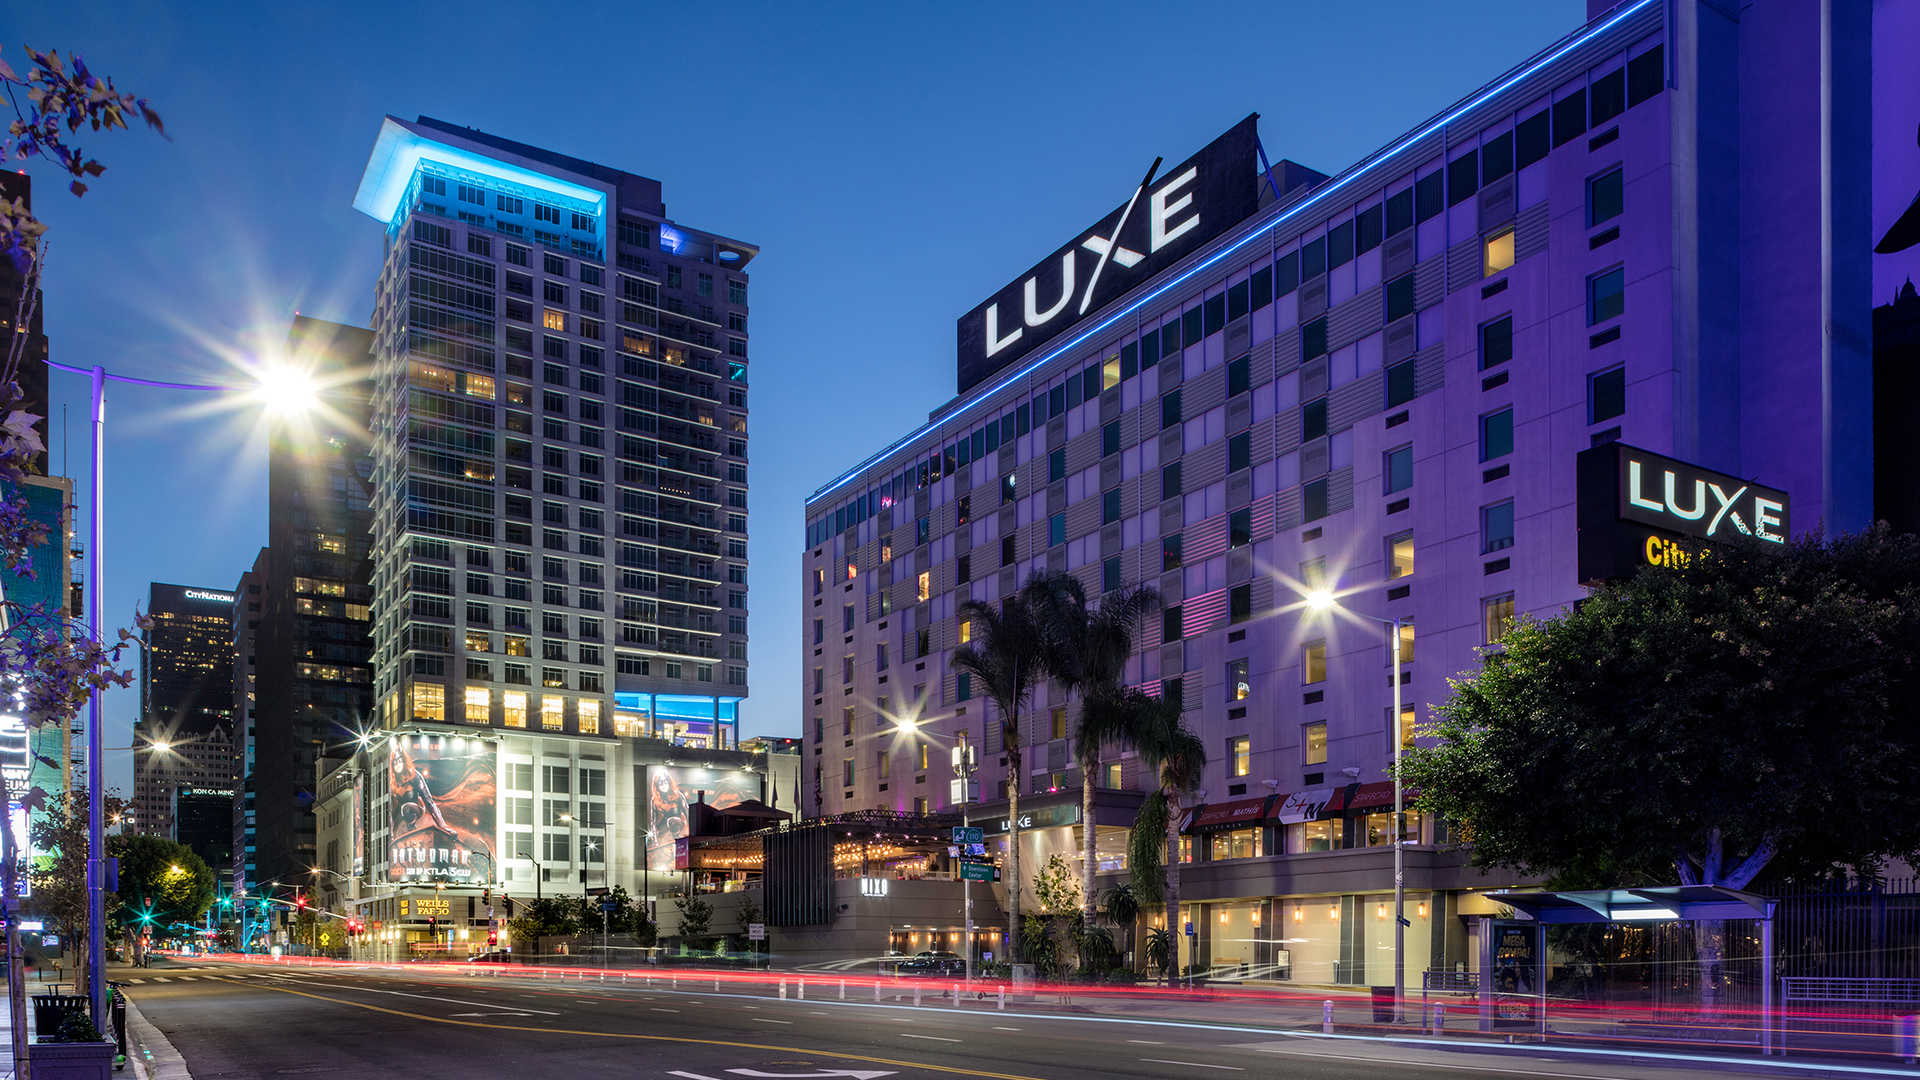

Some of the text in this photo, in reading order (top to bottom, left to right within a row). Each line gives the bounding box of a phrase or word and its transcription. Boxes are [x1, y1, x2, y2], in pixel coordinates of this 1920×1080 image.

[986, 157, 1200, 358] LUXE
[1630, 460, 1784, 545] LUXE
[192, 788, 217, 796] KONCA
[969, 832, 979, 841] 110
[968, 865, 989, 873] Downtown
[861, 878, 888, 895] NIXO
[415, 899, 450, 908] WELLS
[1502, 935, 1526, 947] MEGA
